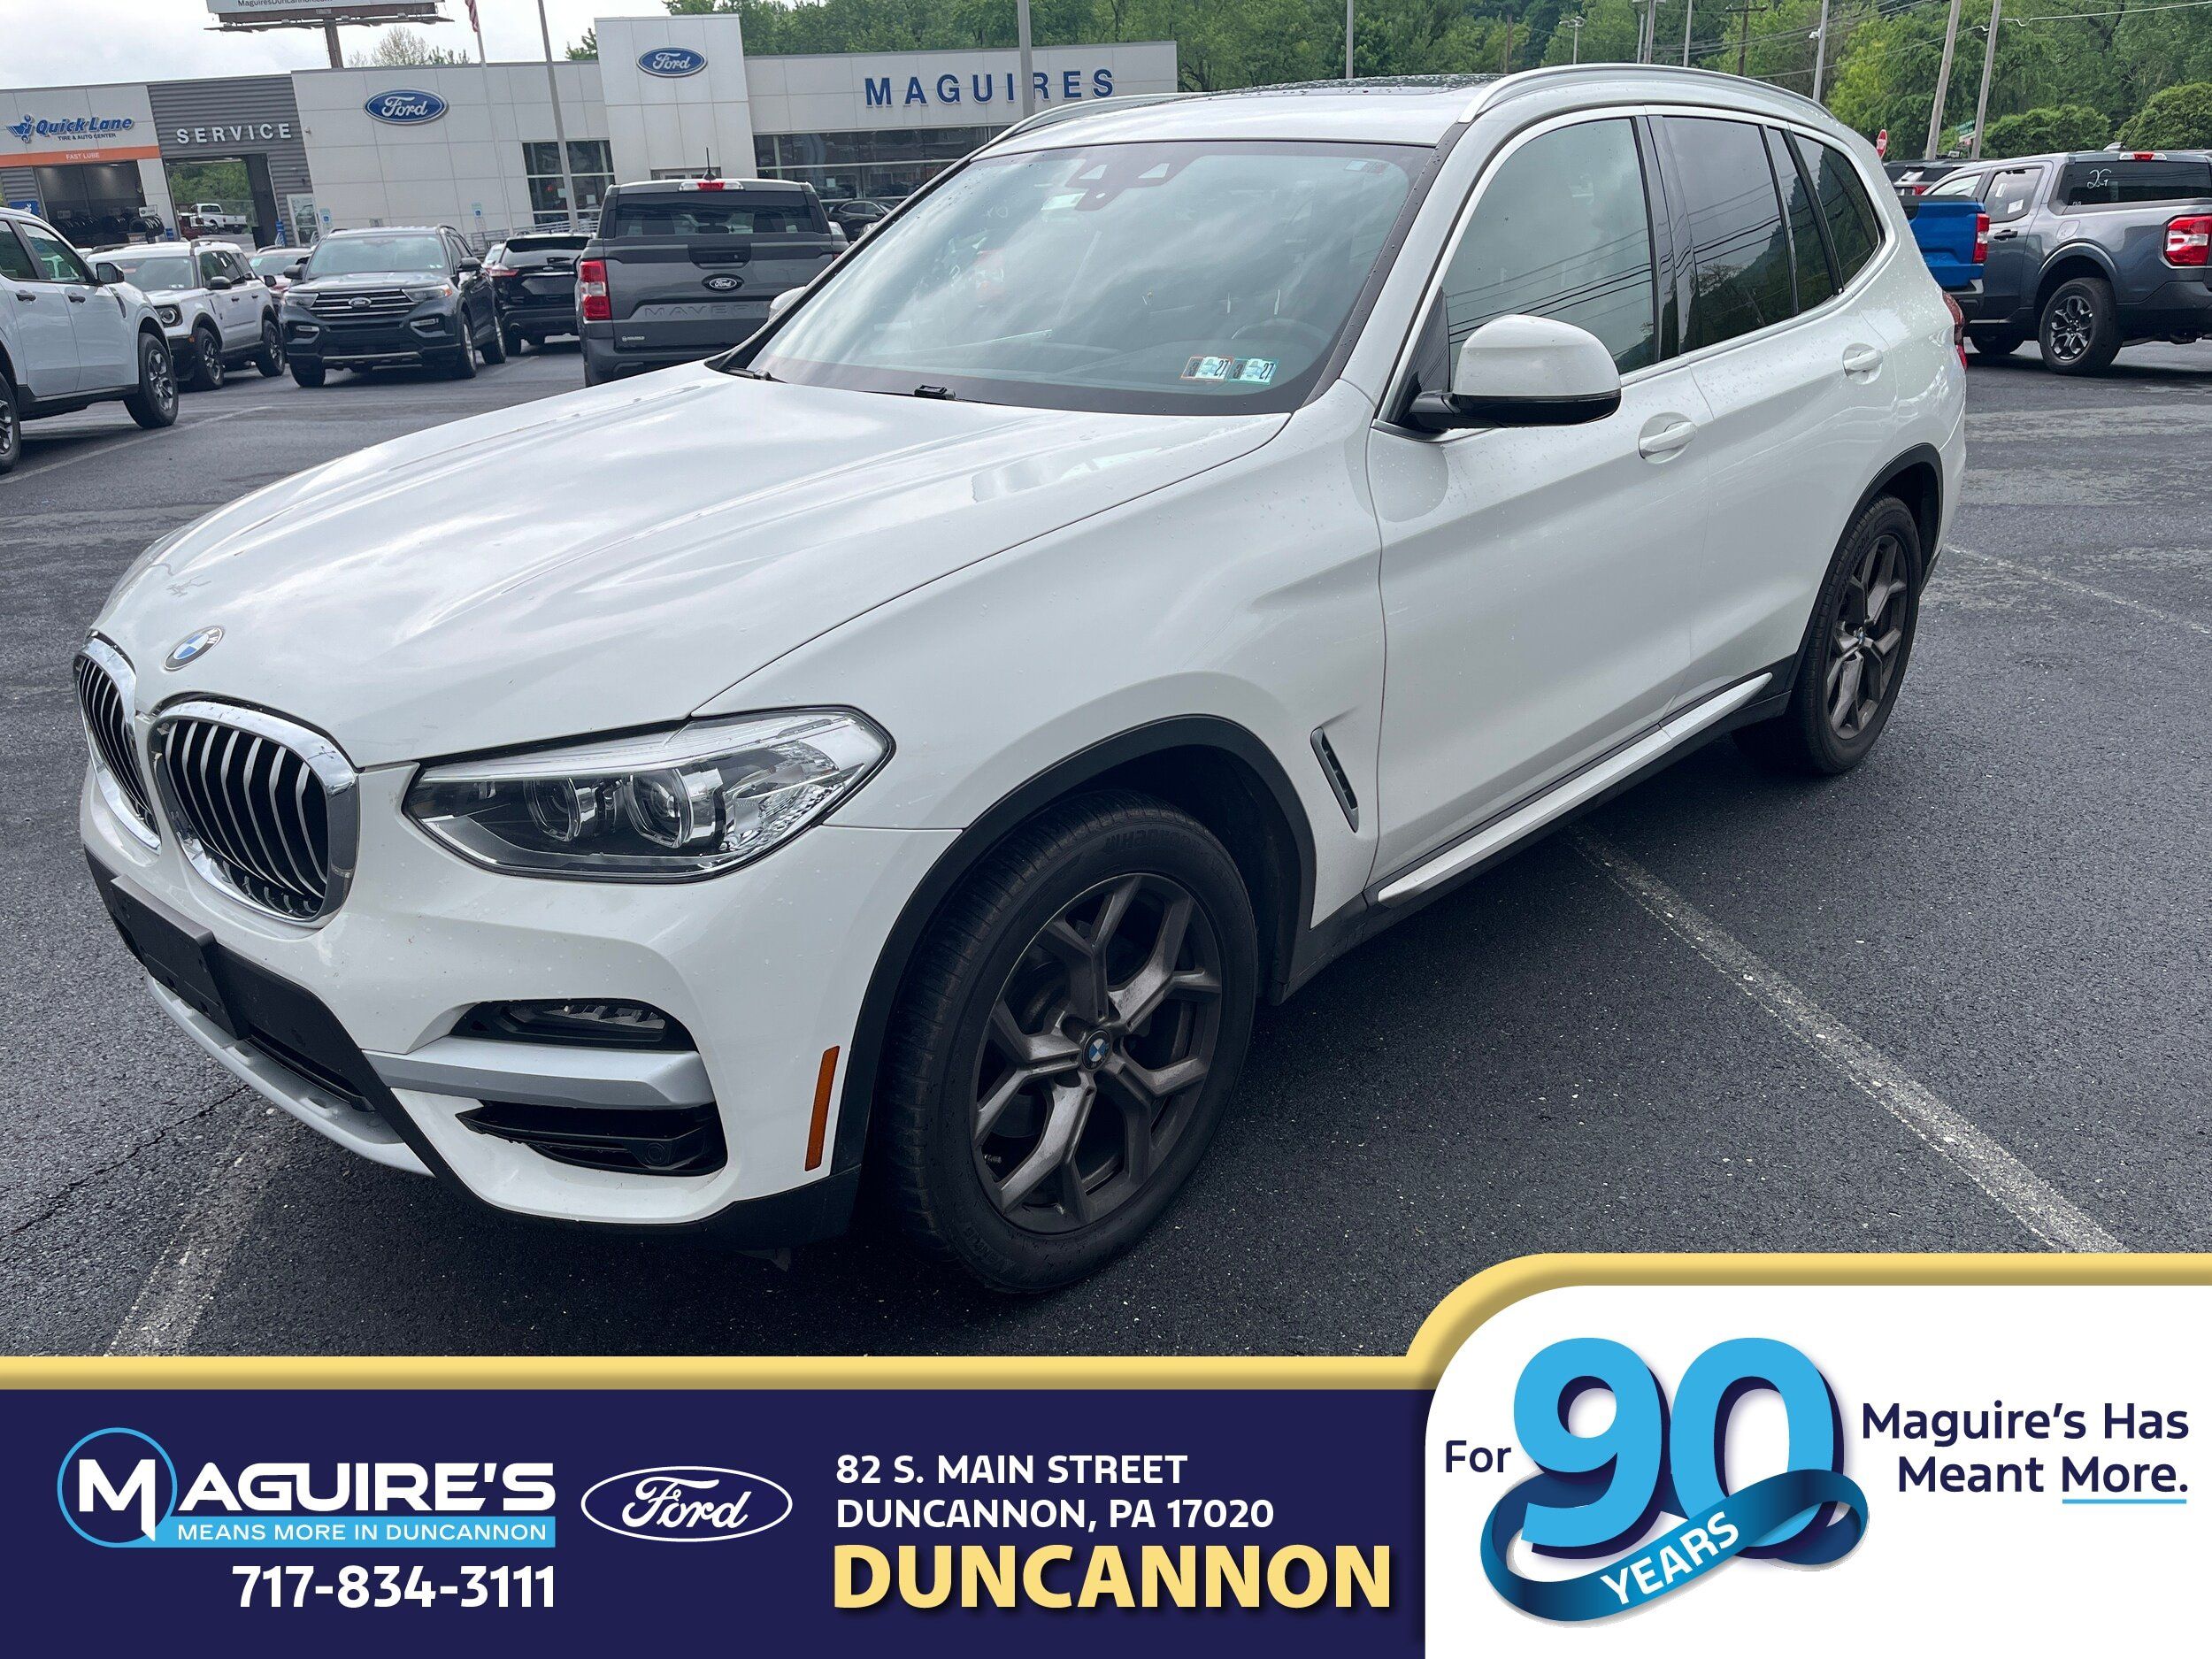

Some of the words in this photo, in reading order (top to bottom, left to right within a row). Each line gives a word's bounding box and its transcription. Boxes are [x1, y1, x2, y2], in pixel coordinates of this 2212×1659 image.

[652, 52, 691, 70] Ford
[864, 69, 1114, 105] MAGUIRES
[381, 96, 428, 117] Ford
[36, 118, 87, 136] Quick
[88, 117, 134, 132] Lane
[177, 123, 292, 144] SERVICE
[714, 278, 732, 288] Ford
[1214, 360, 1229, 377] 27
[1259, 363, 1275, 380] 27
